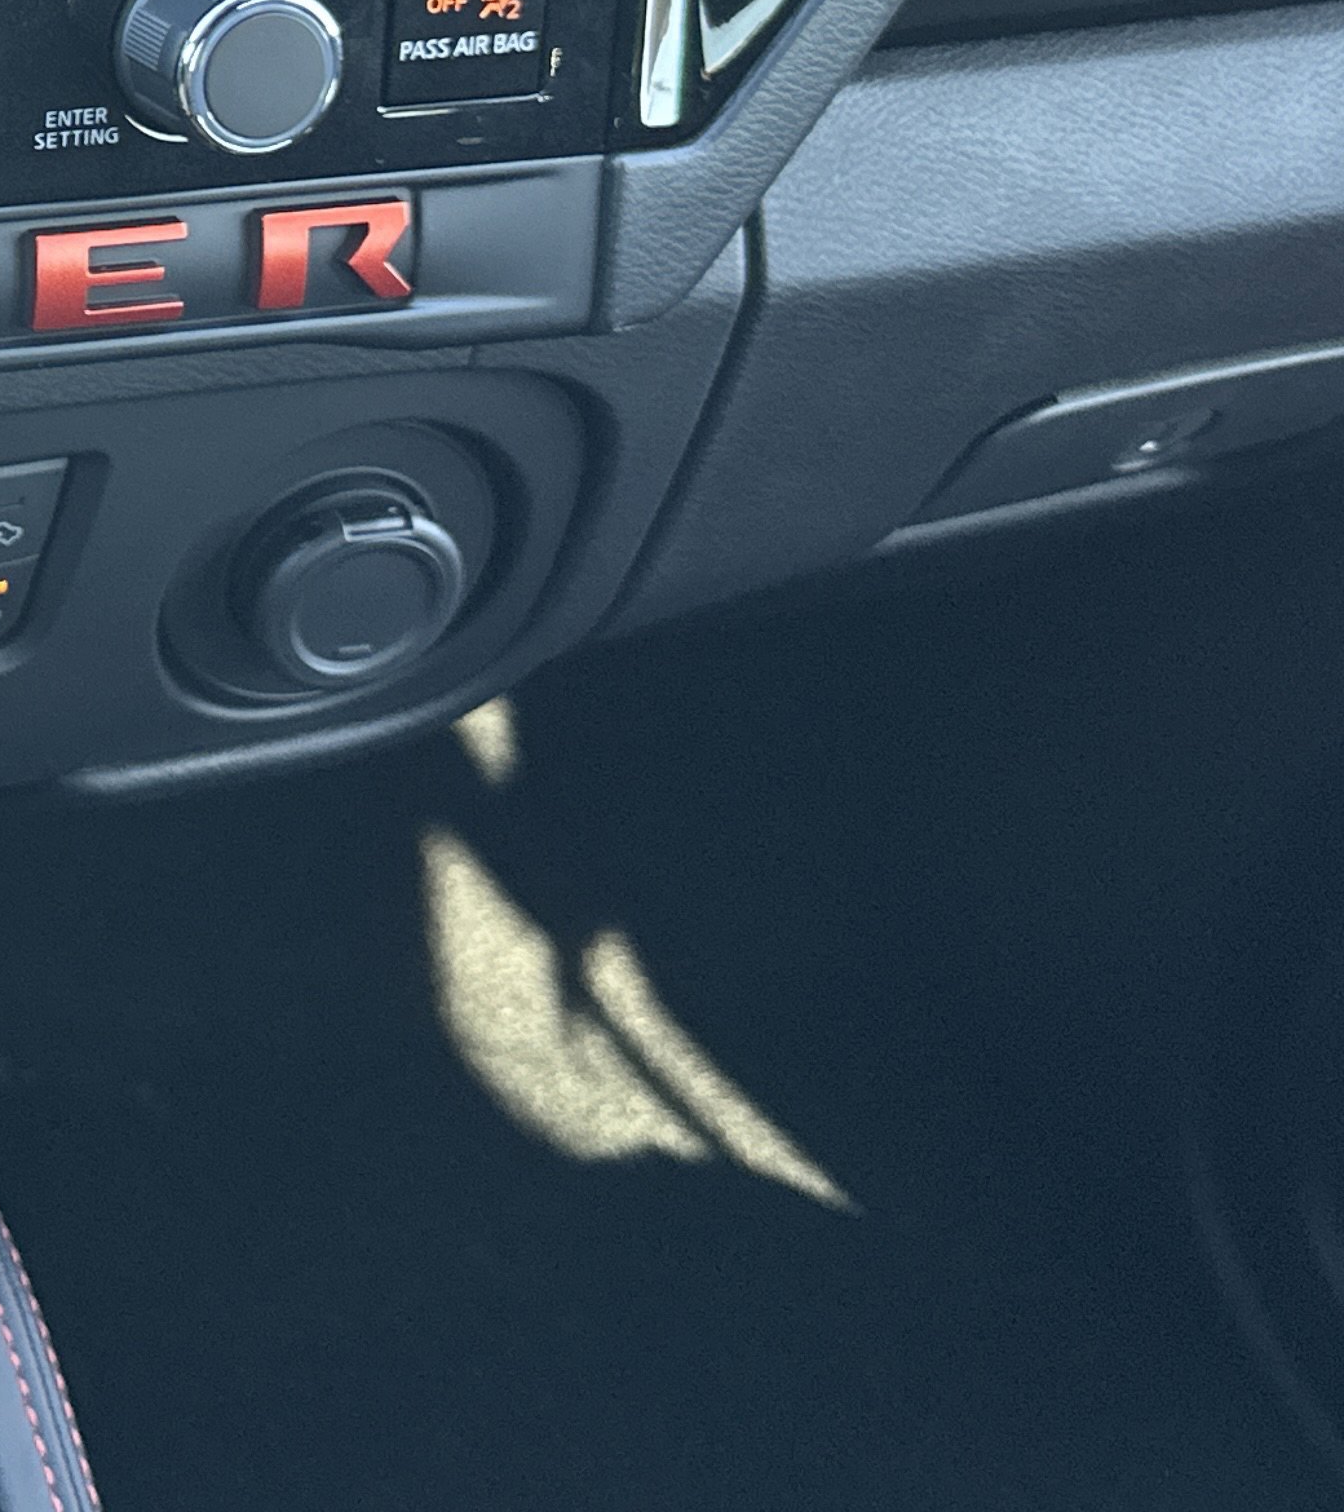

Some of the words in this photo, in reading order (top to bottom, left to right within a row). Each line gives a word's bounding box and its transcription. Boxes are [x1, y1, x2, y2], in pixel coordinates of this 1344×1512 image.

[399, 38, 452, 62] PASS
[452, 34, 490, 57] AIR
[493, 30, 538, 54] BAG
[45, 107, 109, 129] ENTER
[33, 127, 120, 151] SETTING
